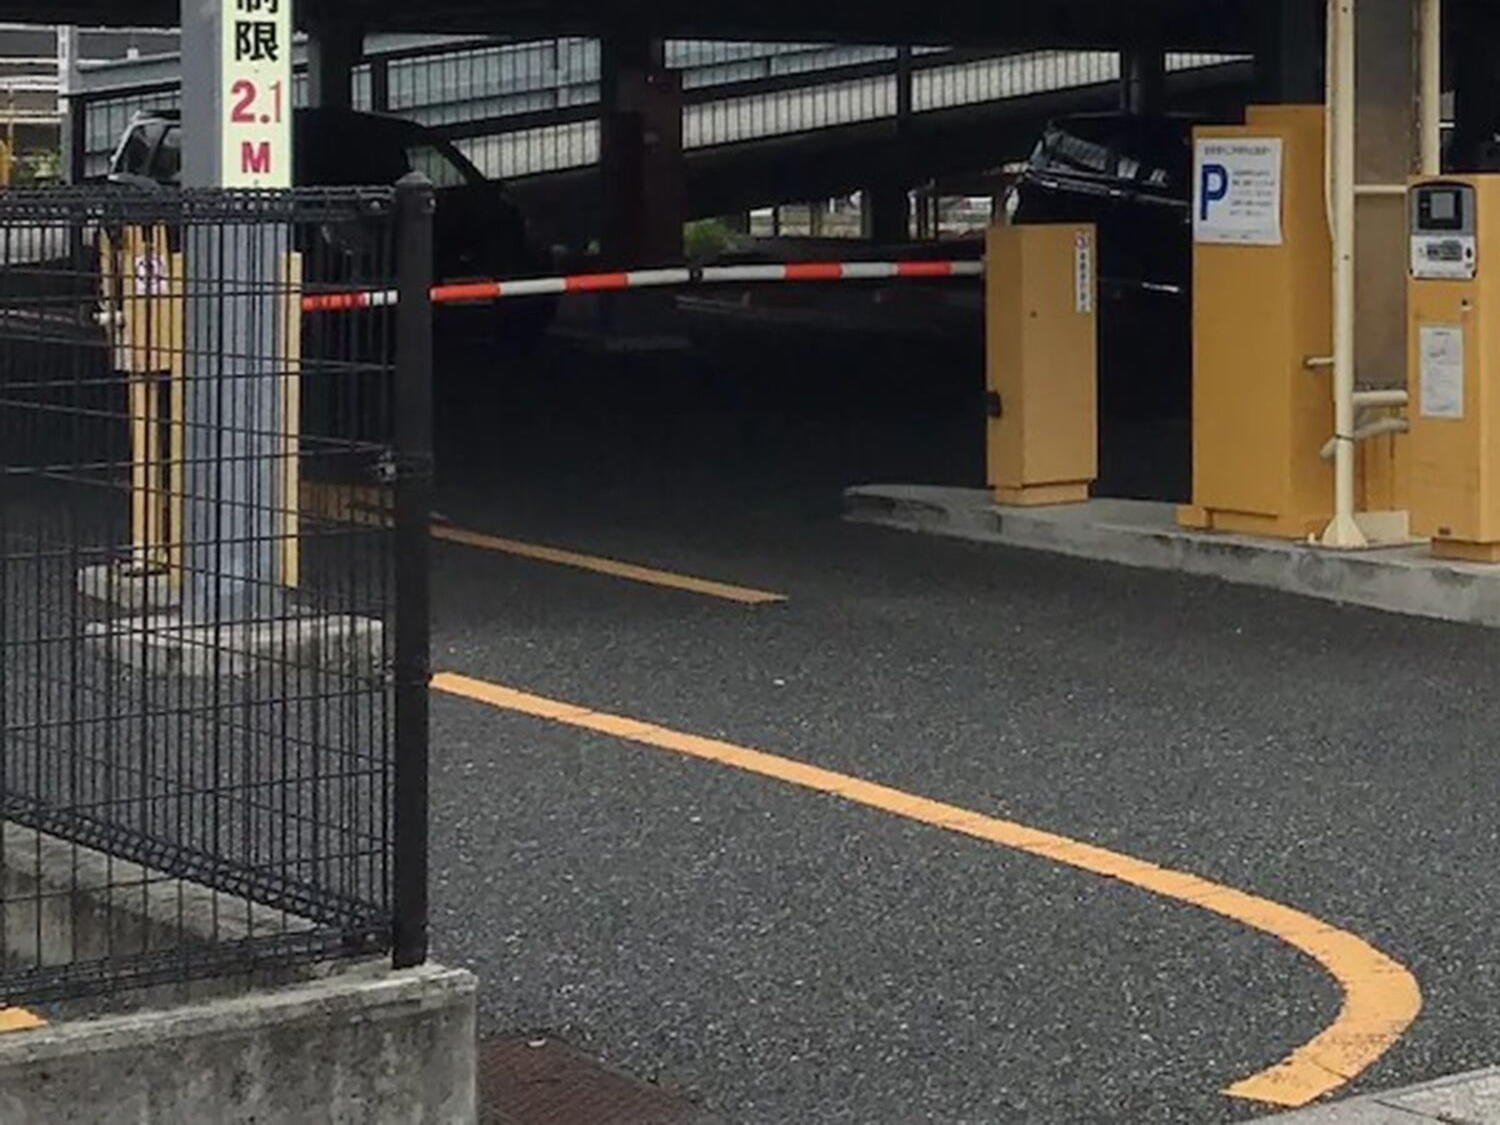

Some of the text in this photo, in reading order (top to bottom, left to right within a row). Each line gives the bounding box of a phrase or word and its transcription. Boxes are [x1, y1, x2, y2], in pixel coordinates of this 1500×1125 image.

[231, 80, 282, 124] 2.1
[240, 141, 271, 174] M
[1201, 164, 1228, 221] P
